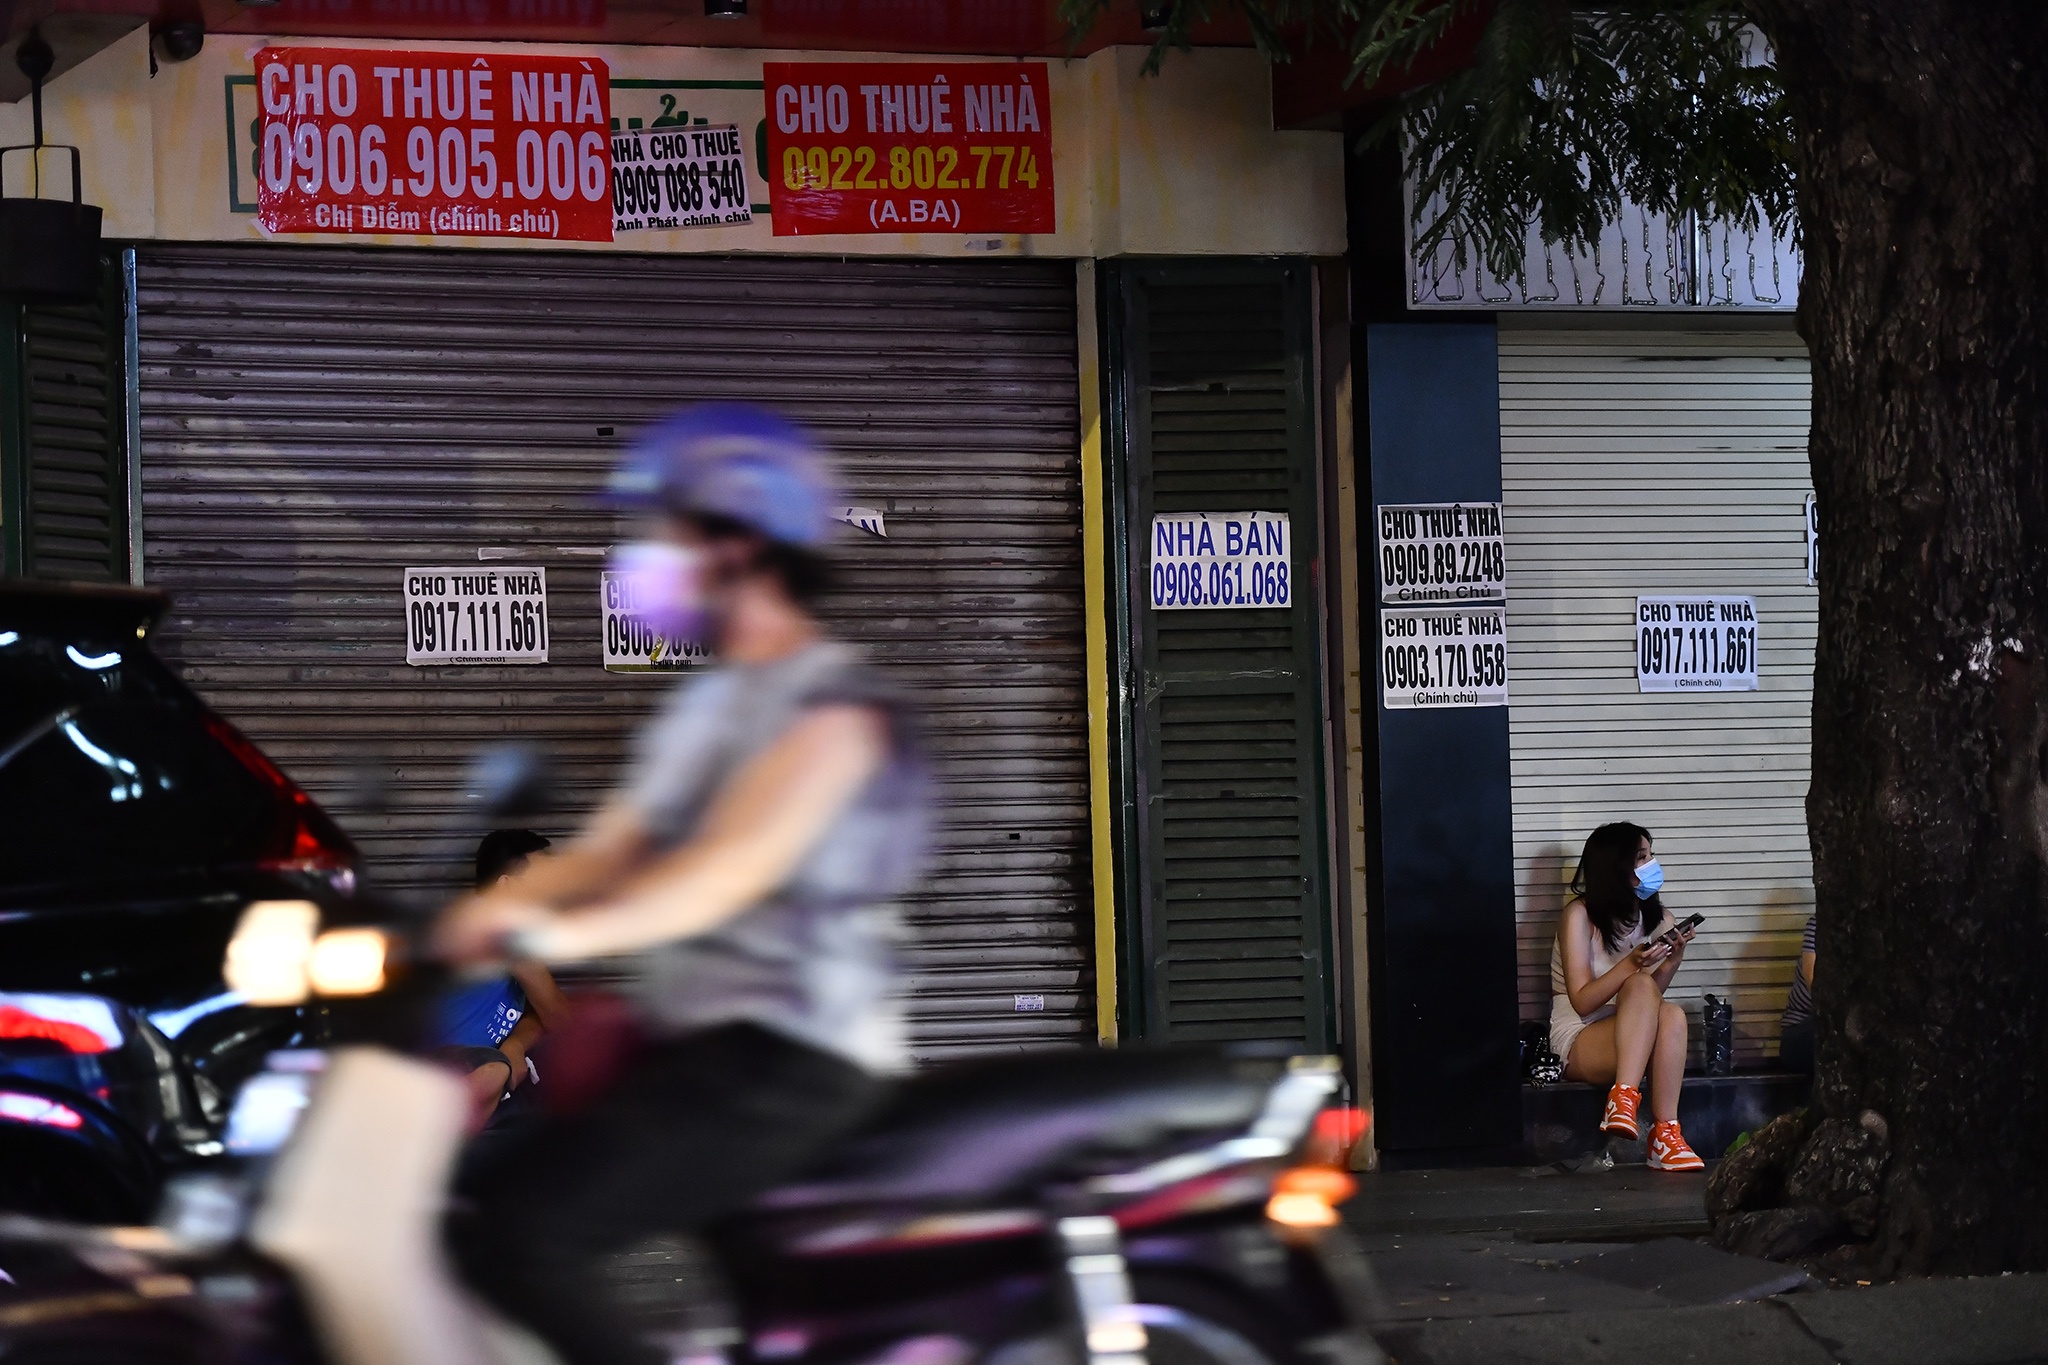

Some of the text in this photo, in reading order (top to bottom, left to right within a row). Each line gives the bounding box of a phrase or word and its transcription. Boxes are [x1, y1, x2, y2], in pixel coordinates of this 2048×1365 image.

[262, 63, 357, 117] CHO
[373, 57, 495, 121] THUÊ
[511, 60, 605, 124] NHÀ
[775, 84, 849, 134] CHO
[860, 74, 953, 133] THUÊ
[963, 74, 1041, 133] NHÀ
[263, 122, 606, 201] 0906.905.006
[611, 131, 645, 163] NHÀ
[650, 134, 688, 160] CHO
[691, 124, 741, 157] THUÊ
[612, 158, 745, 216] 0909 088 540
[782, 146, 1039, 190] 0922.802.774
[616, 208, 750, 231] Anh Phát chính chủ
[869, 199, 961, 229] (A.BA)
[1157, 512, 1283, 556] NHÀ BÁN
[1381, 503, 1502, 540] CHO THUÊ NHÀ
[409, 571, 543, 596] CHO THUÊ NHÀ
[1153, 561, 1288, 606] 0908.061.068
[1383, 541, 1505, 586] 0909.89.2248
[1397, 585, 1491, 601] Chính Chủ
[1640, 600, 1755, 622] CHO THUÊ NHÀ
[411, 600, 545, 652] 0917.111.661
[1385, 613, 1503, 637] CHO THUÊ NHÀ
[1385, 643, 1506, 689] 0903.170.958
[1641, 626, 1755, 674] 0917.111.661
[1413, 690, 1478, 706] (Chính chủ)
